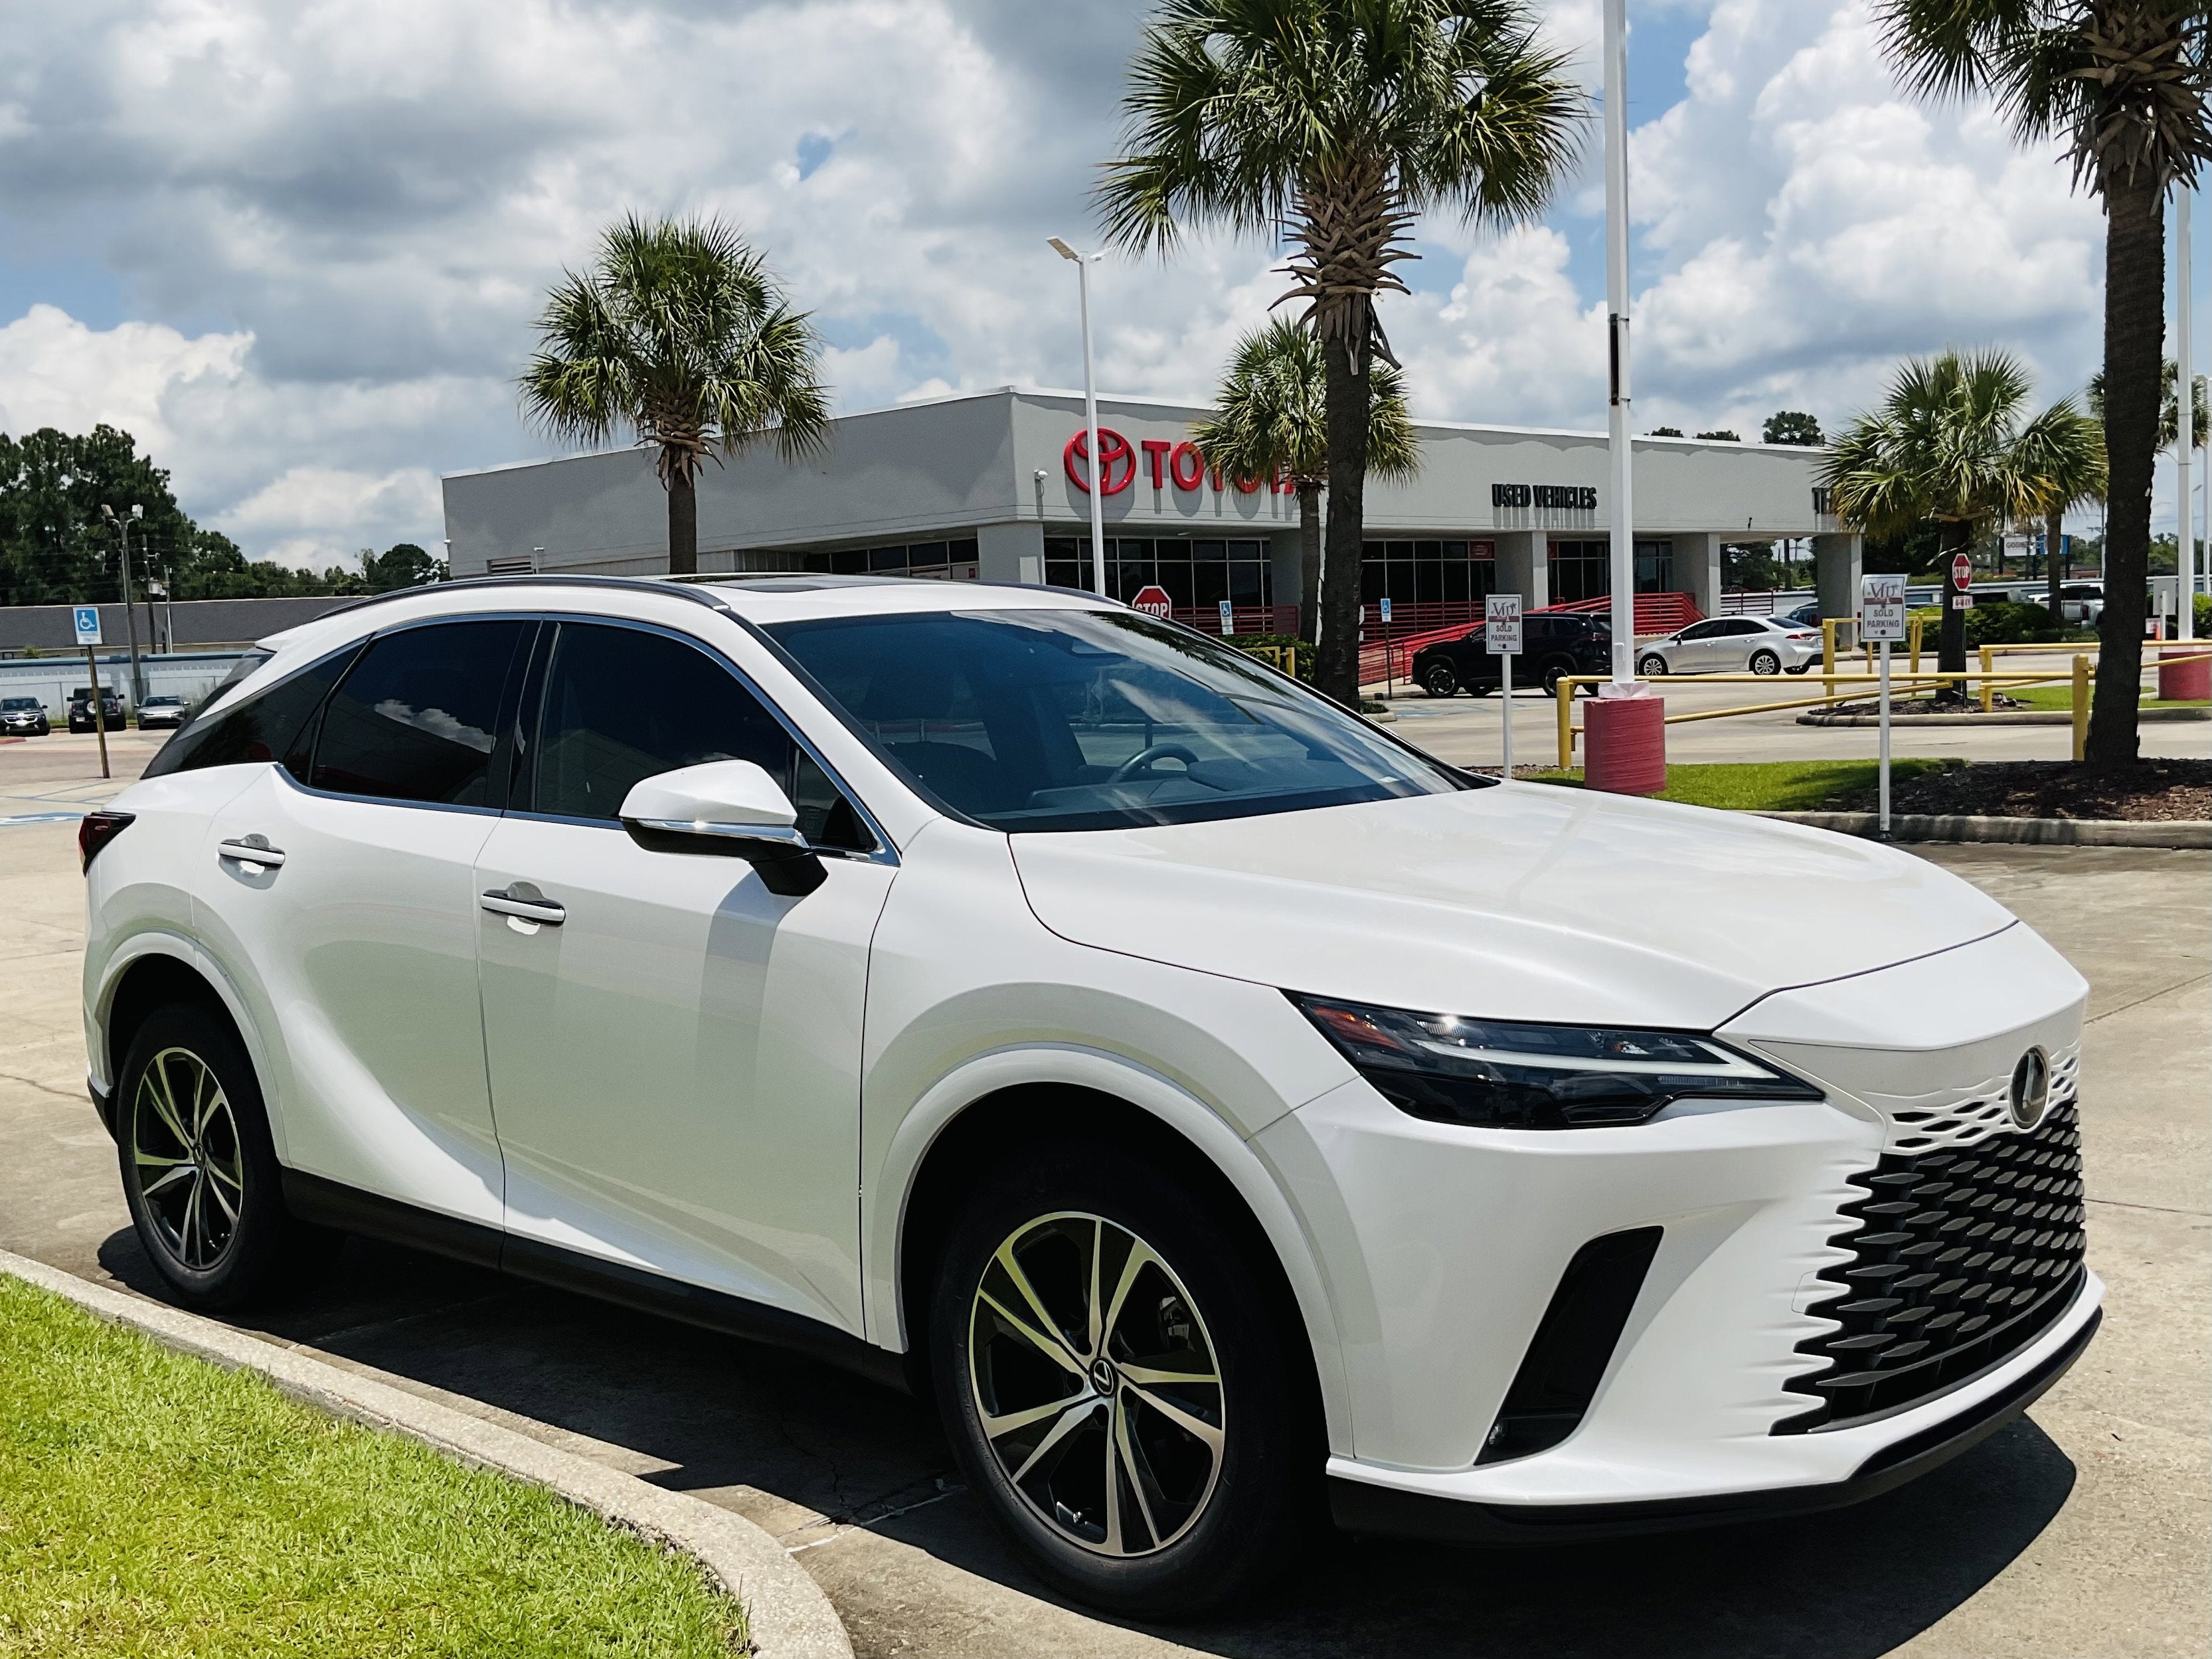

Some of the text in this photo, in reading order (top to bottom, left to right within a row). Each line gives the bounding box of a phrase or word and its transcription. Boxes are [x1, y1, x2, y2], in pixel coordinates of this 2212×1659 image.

[1141, 440, 1295, 494] TOO
[1491, 483, 1597, 509] USED VEHICLES
[1954, 567, 1970, 578] STOP
